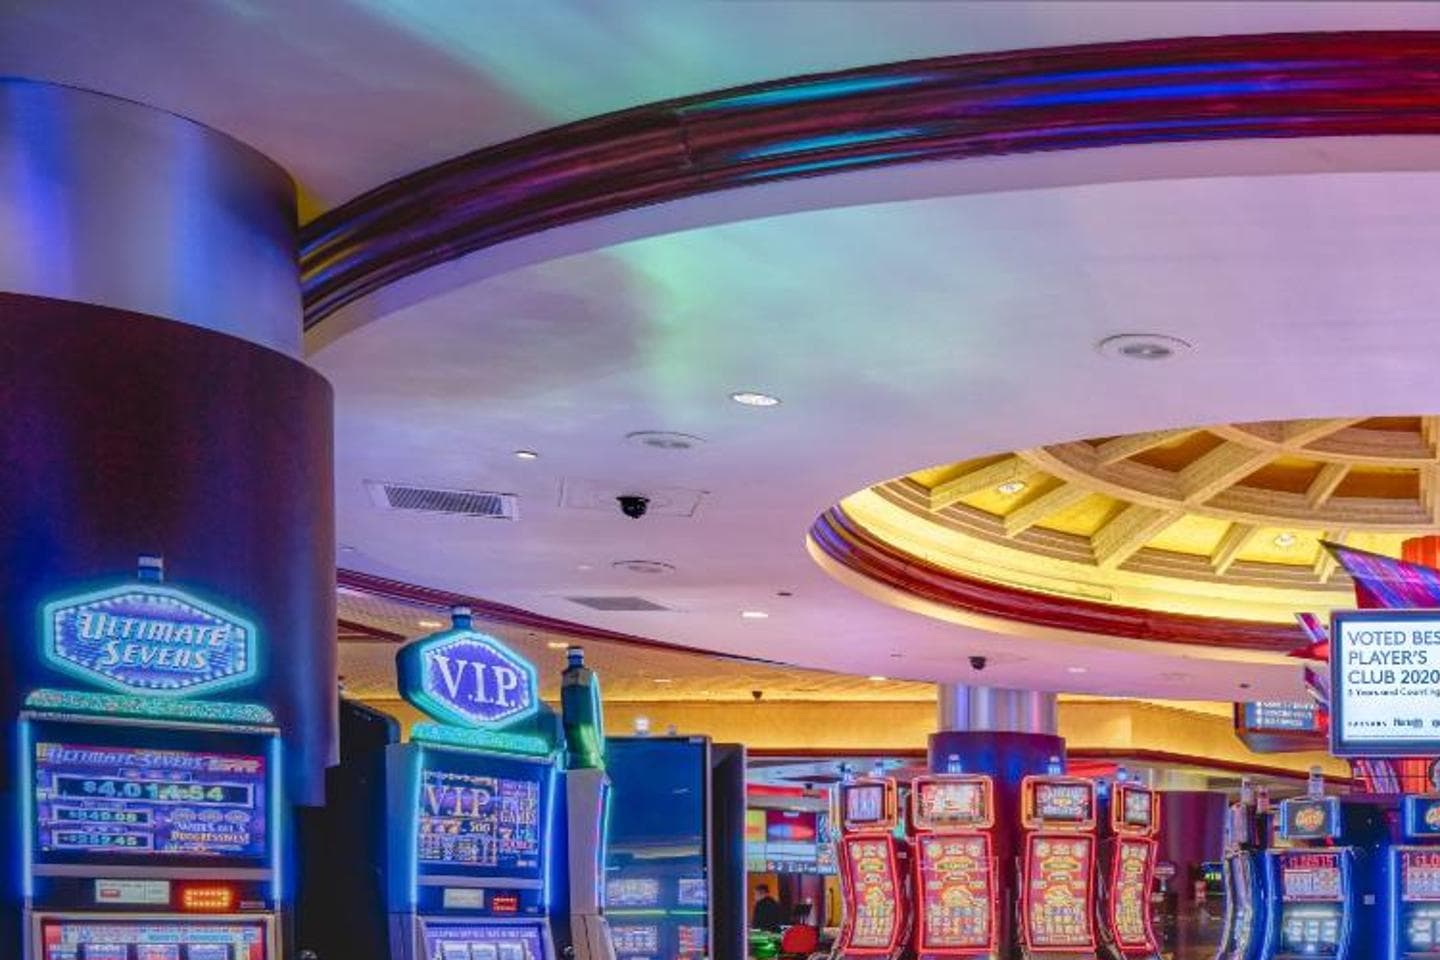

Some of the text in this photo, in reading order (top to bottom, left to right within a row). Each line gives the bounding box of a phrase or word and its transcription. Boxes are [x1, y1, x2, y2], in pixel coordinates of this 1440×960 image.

[78, 611, 227, 647] ULTIMATE
[1347, 630, 1406, 646] VOTED
[102, 640, 208, 669] SEVENS
[1348, 650, 1428, 665] PLAYER'S
[1347, 669, 1440, 685] CLUB 2020
